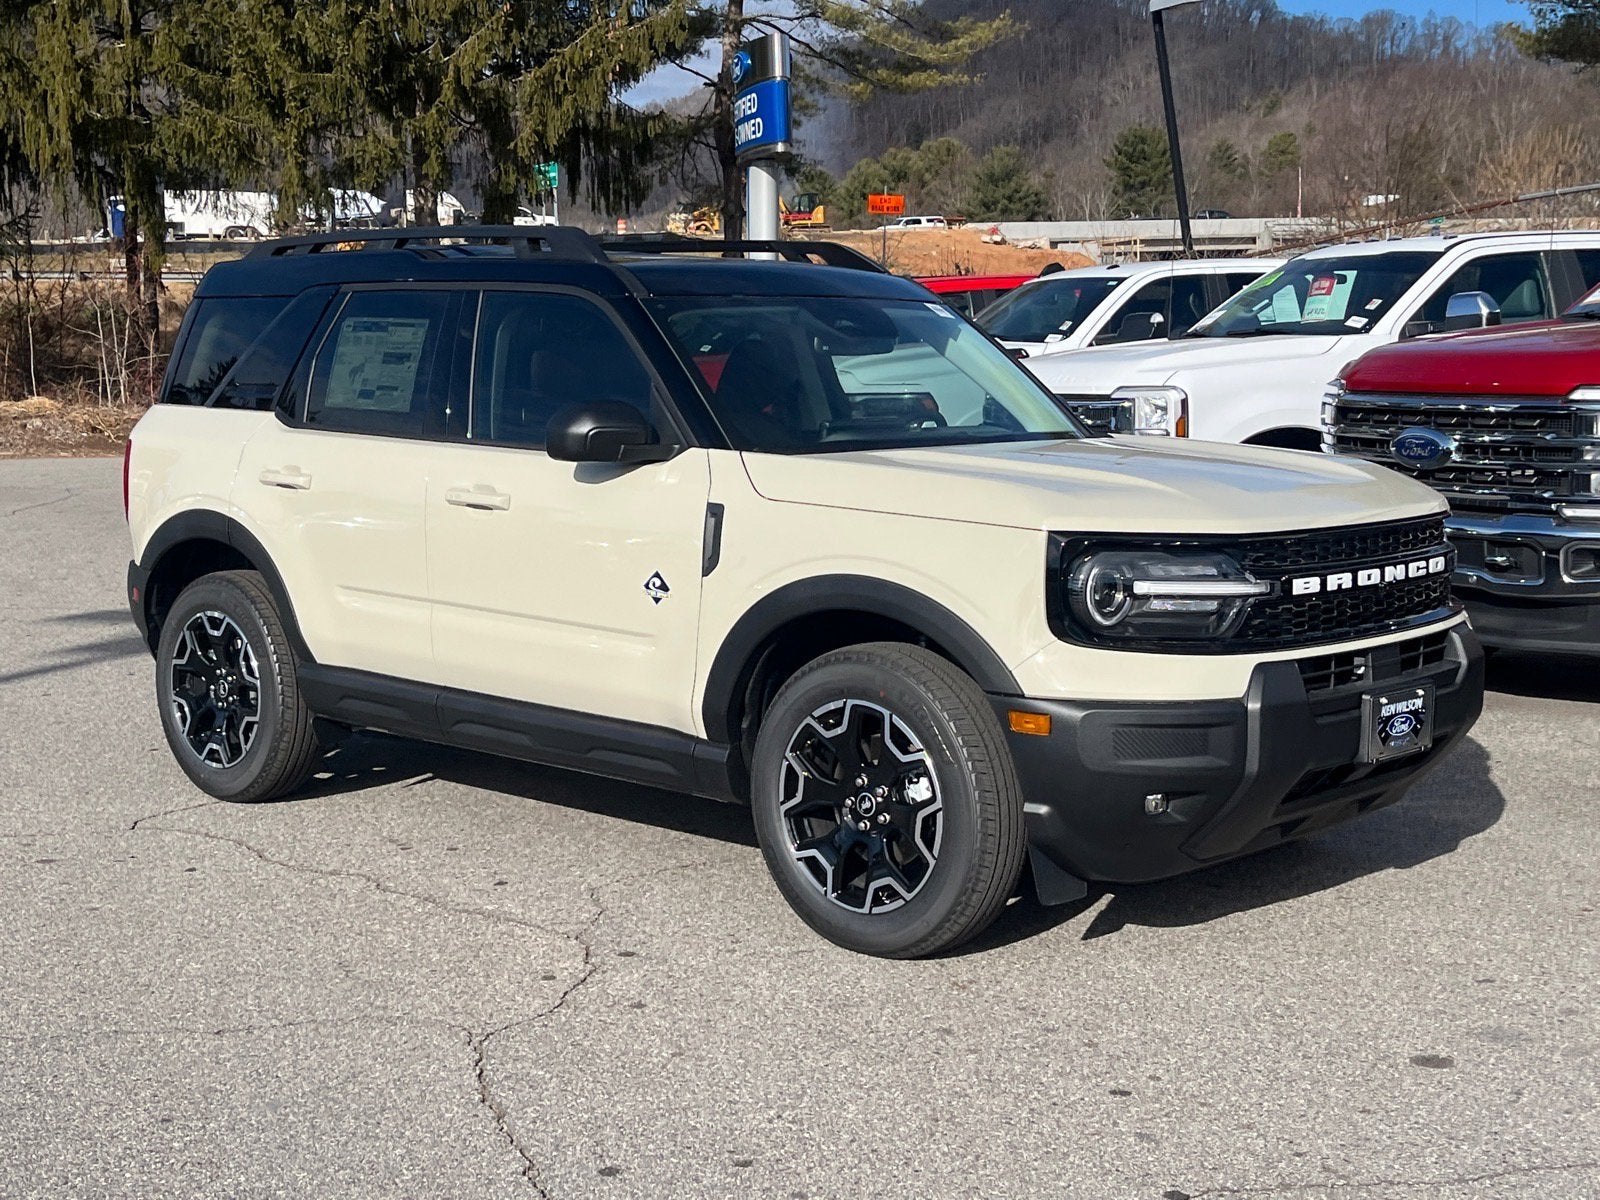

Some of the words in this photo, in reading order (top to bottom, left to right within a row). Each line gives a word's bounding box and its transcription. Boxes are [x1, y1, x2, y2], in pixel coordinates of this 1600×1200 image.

[1401, 438, 1432, 457] Ford
[1292, 556, 1446, 596] BRONCO
[1380, 703, 1396, 717] KEN
[1396, 697, 1424, 714] WILSON
[1391, 717, 1410, 734] Ford
